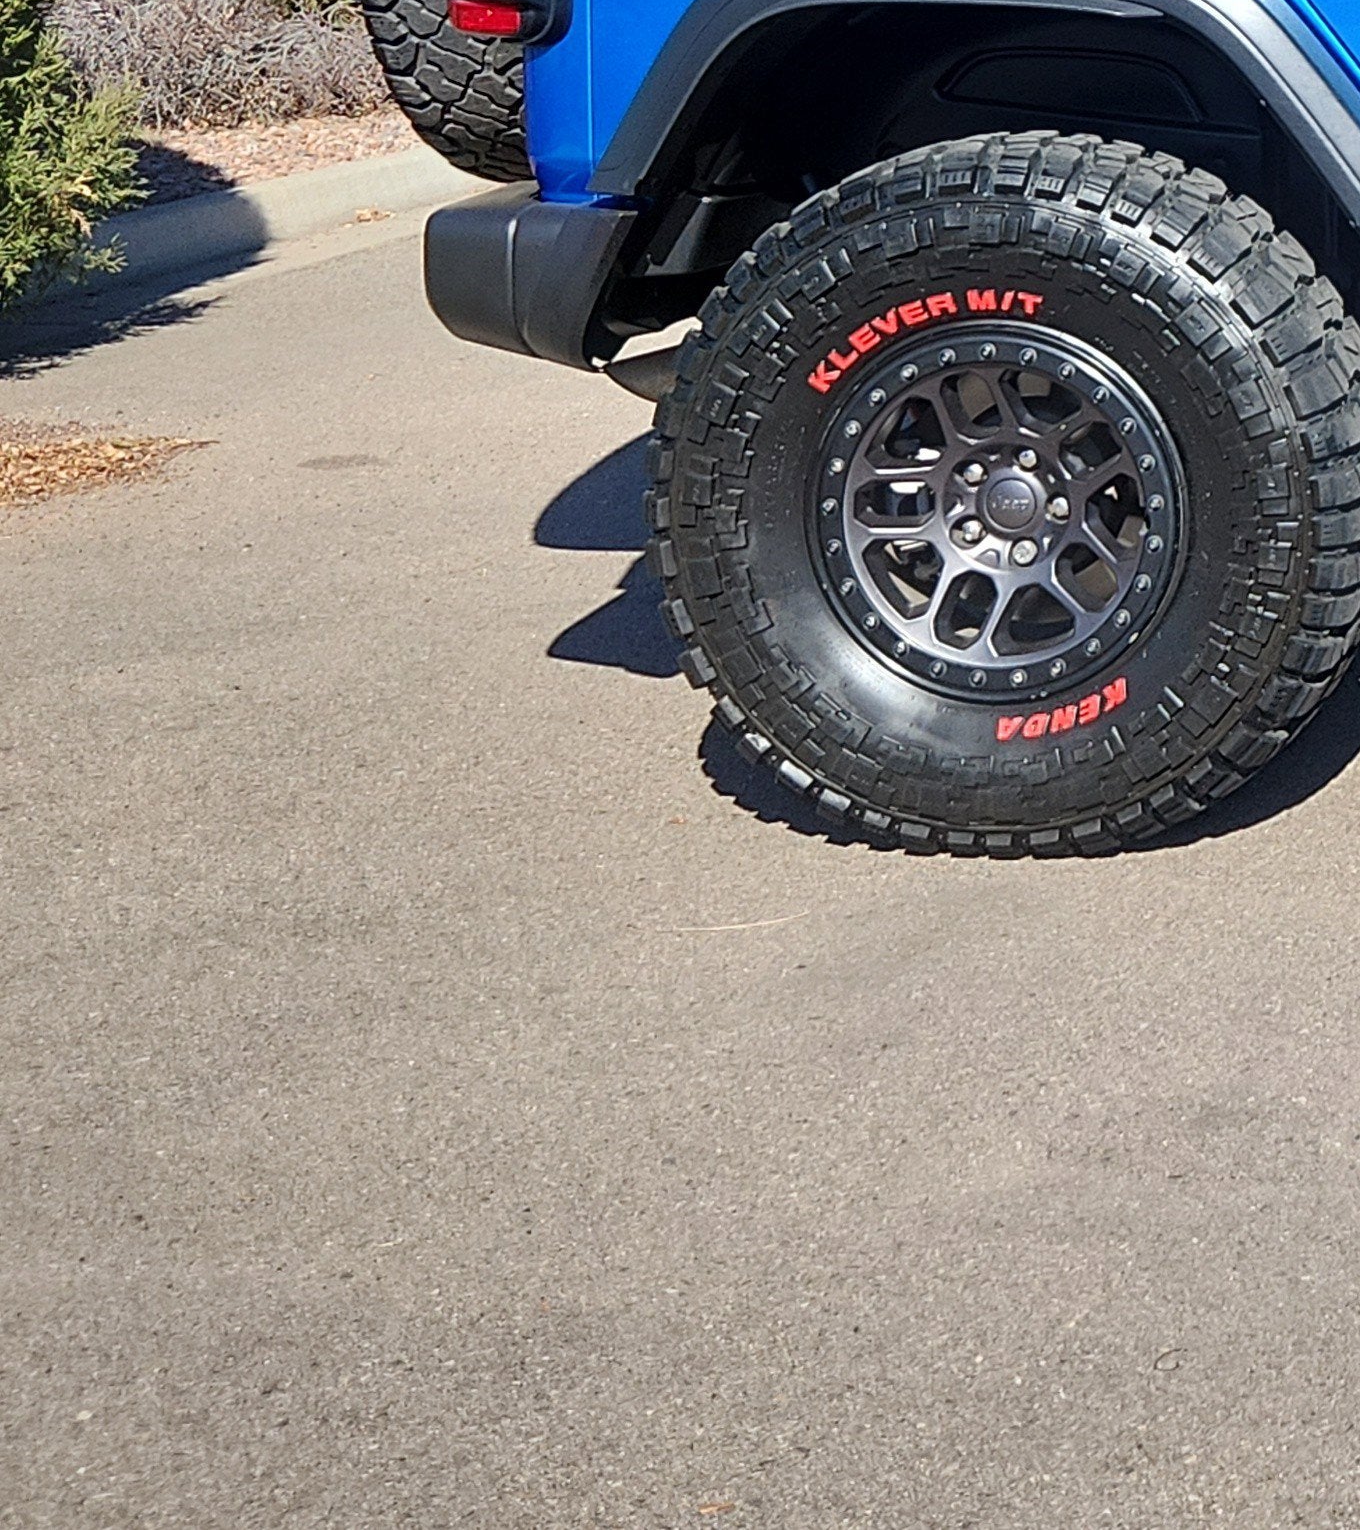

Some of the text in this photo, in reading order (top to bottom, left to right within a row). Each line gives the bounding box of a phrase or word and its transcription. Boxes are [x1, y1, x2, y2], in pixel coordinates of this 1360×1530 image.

[806, 288, 1044, 395] KLEVER M/T
[995, 676, 1128, 742] KENDA
